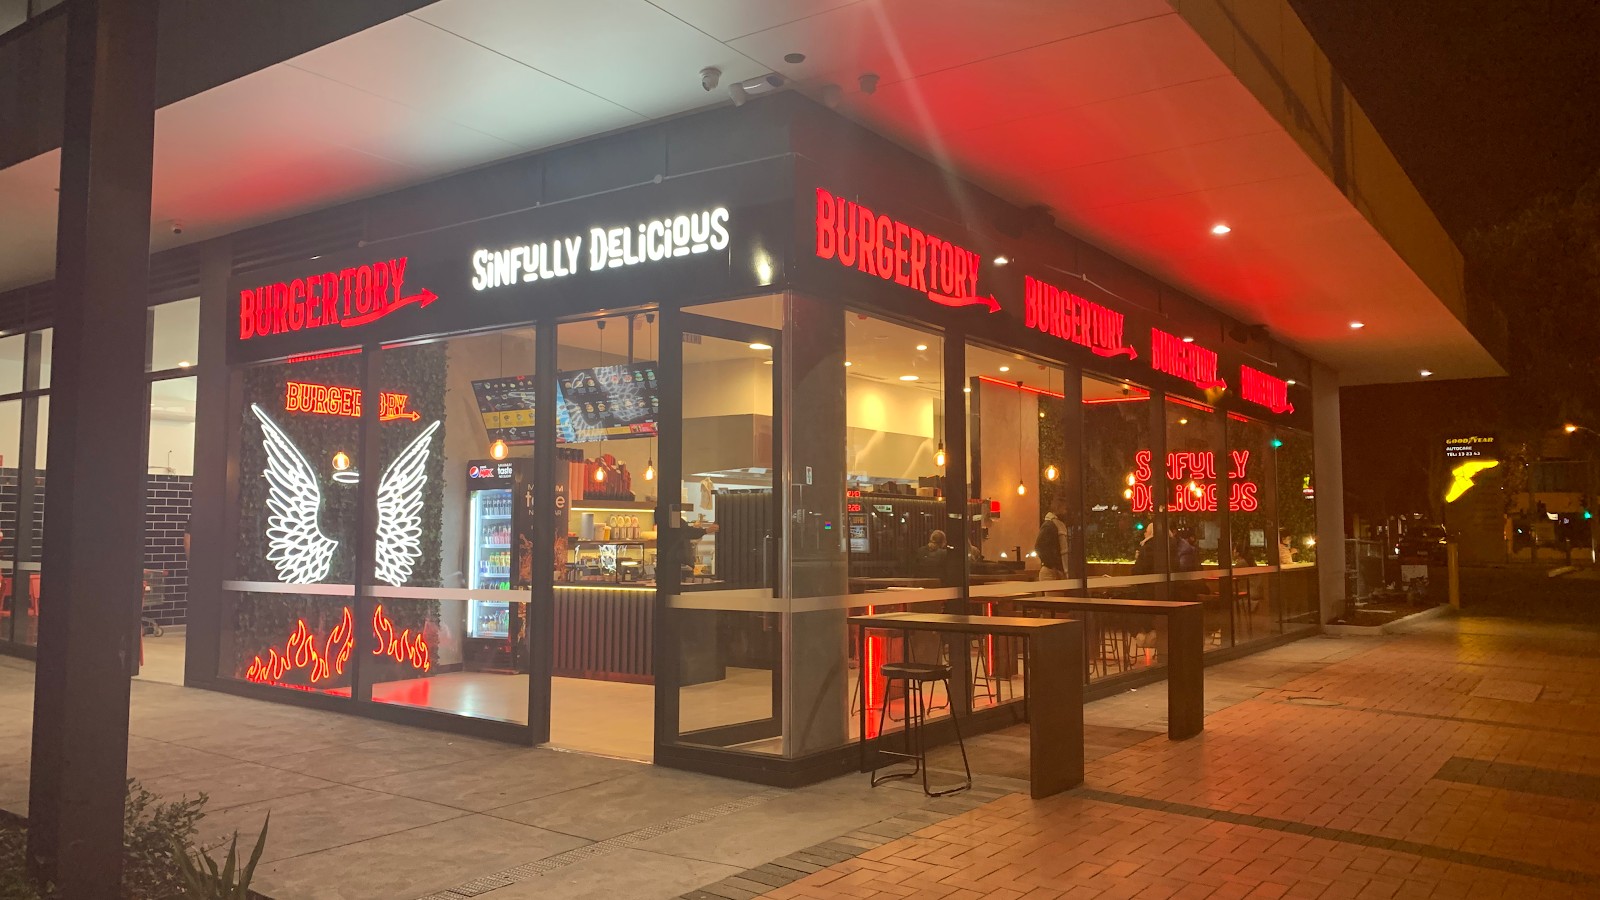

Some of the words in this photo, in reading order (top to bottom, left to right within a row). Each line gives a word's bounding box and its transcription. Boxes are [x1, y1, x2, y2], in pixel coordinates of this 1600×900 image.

[816, 187, 981, 300] BURGERTORY
[239, 257, 408, 340] BURGERTORY
[1025, 275, 1125, 351] BURGERTORY
[1446, 436, 1494, 444] GOODYEAR
